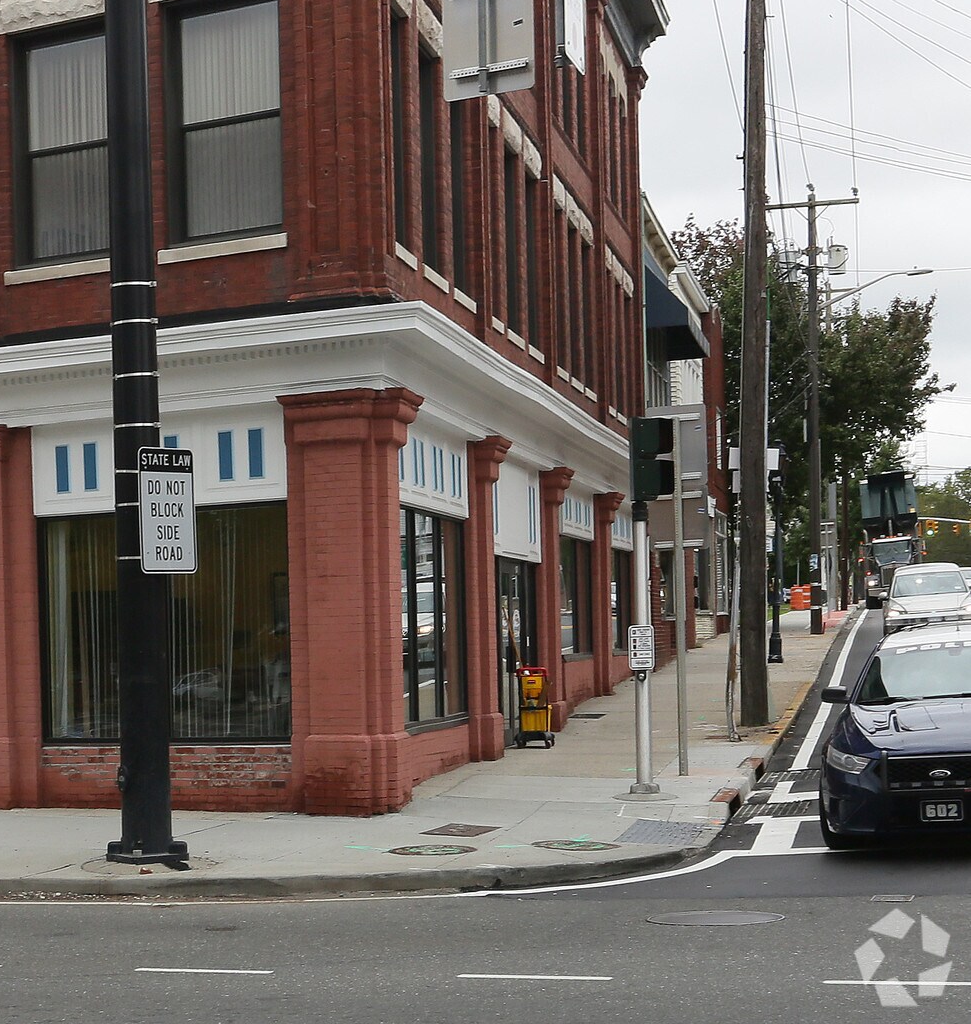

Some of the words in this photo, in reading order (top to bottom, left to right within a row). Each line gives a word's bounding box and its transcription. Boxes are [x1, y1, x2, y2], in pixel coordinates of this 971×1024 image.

[141, 453, 169, 466] STATE
[172, 454, 191, 466] LAW
[147, 480, 161, 495] DO
[166, 480, 185, 495] NOT
[150, 502, 184, 517] BLOCK
[156, 525, 180, 540] SIDE
[155, 546, 183, 561] ROAD
[925, 803, 958, 817] 602
